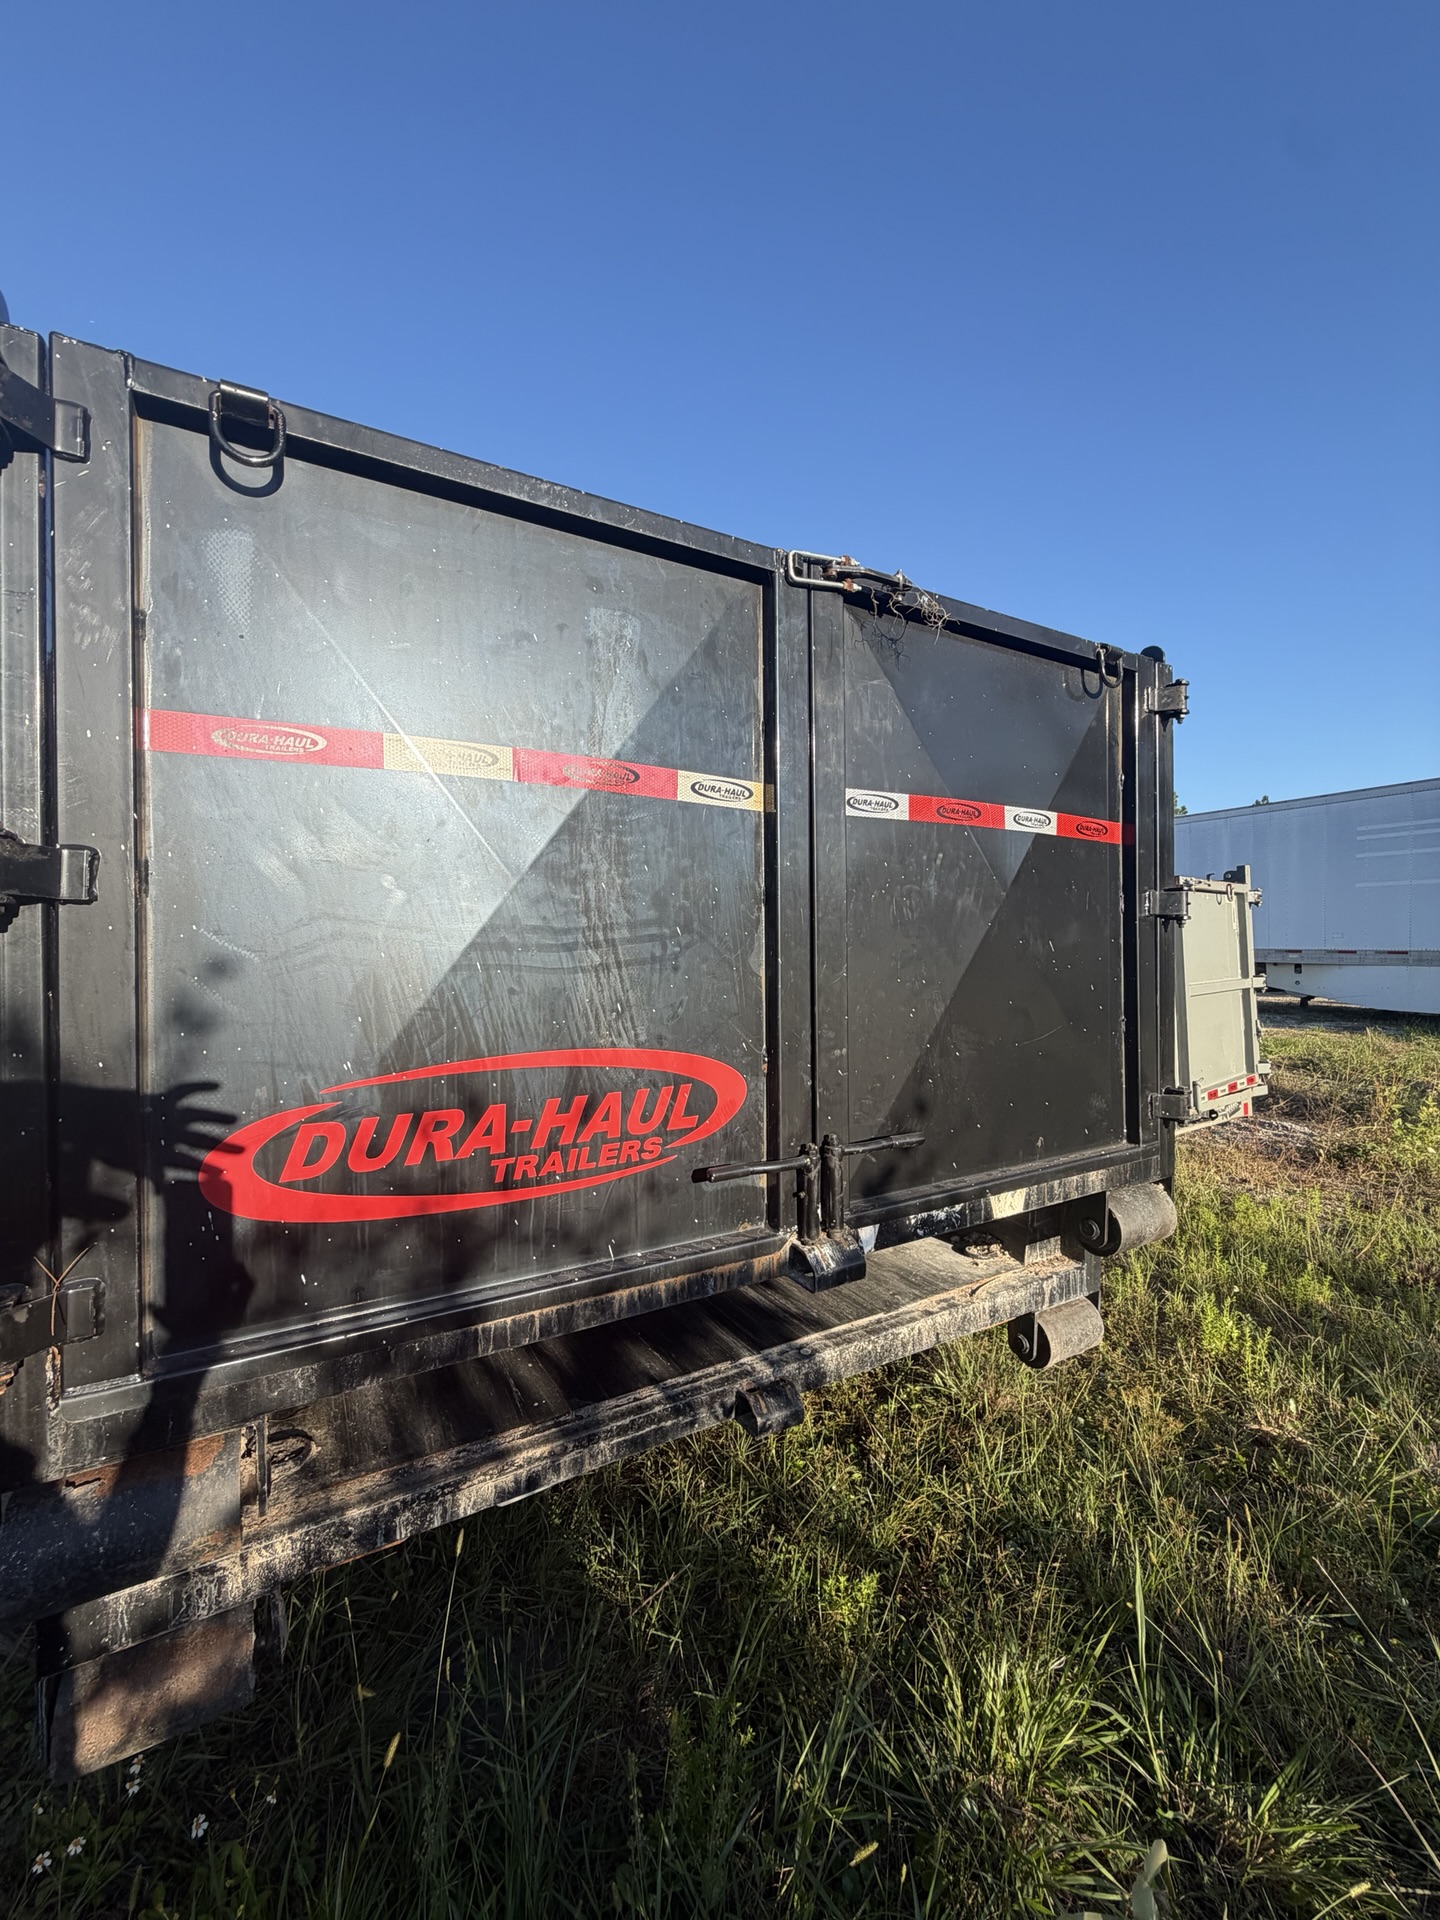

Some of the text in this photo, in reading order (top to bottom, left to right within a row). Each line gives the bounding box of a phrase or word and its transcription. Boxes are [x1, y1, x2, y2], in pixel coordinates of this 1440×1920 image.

[226, 730, 315, 748] DURA-HAUL
[264, 744, 305, 753] TRAILERS
[697, 783, 747, 798] DURA-HAUL
[852, 798, 893, 809] DURA-HAUL
[941, 807, 977, 817] DURA-HAUL
[278, 1083, 700, 1184] DURA-HAUL
[490, 1137, 663, 1183] TRAILERS
